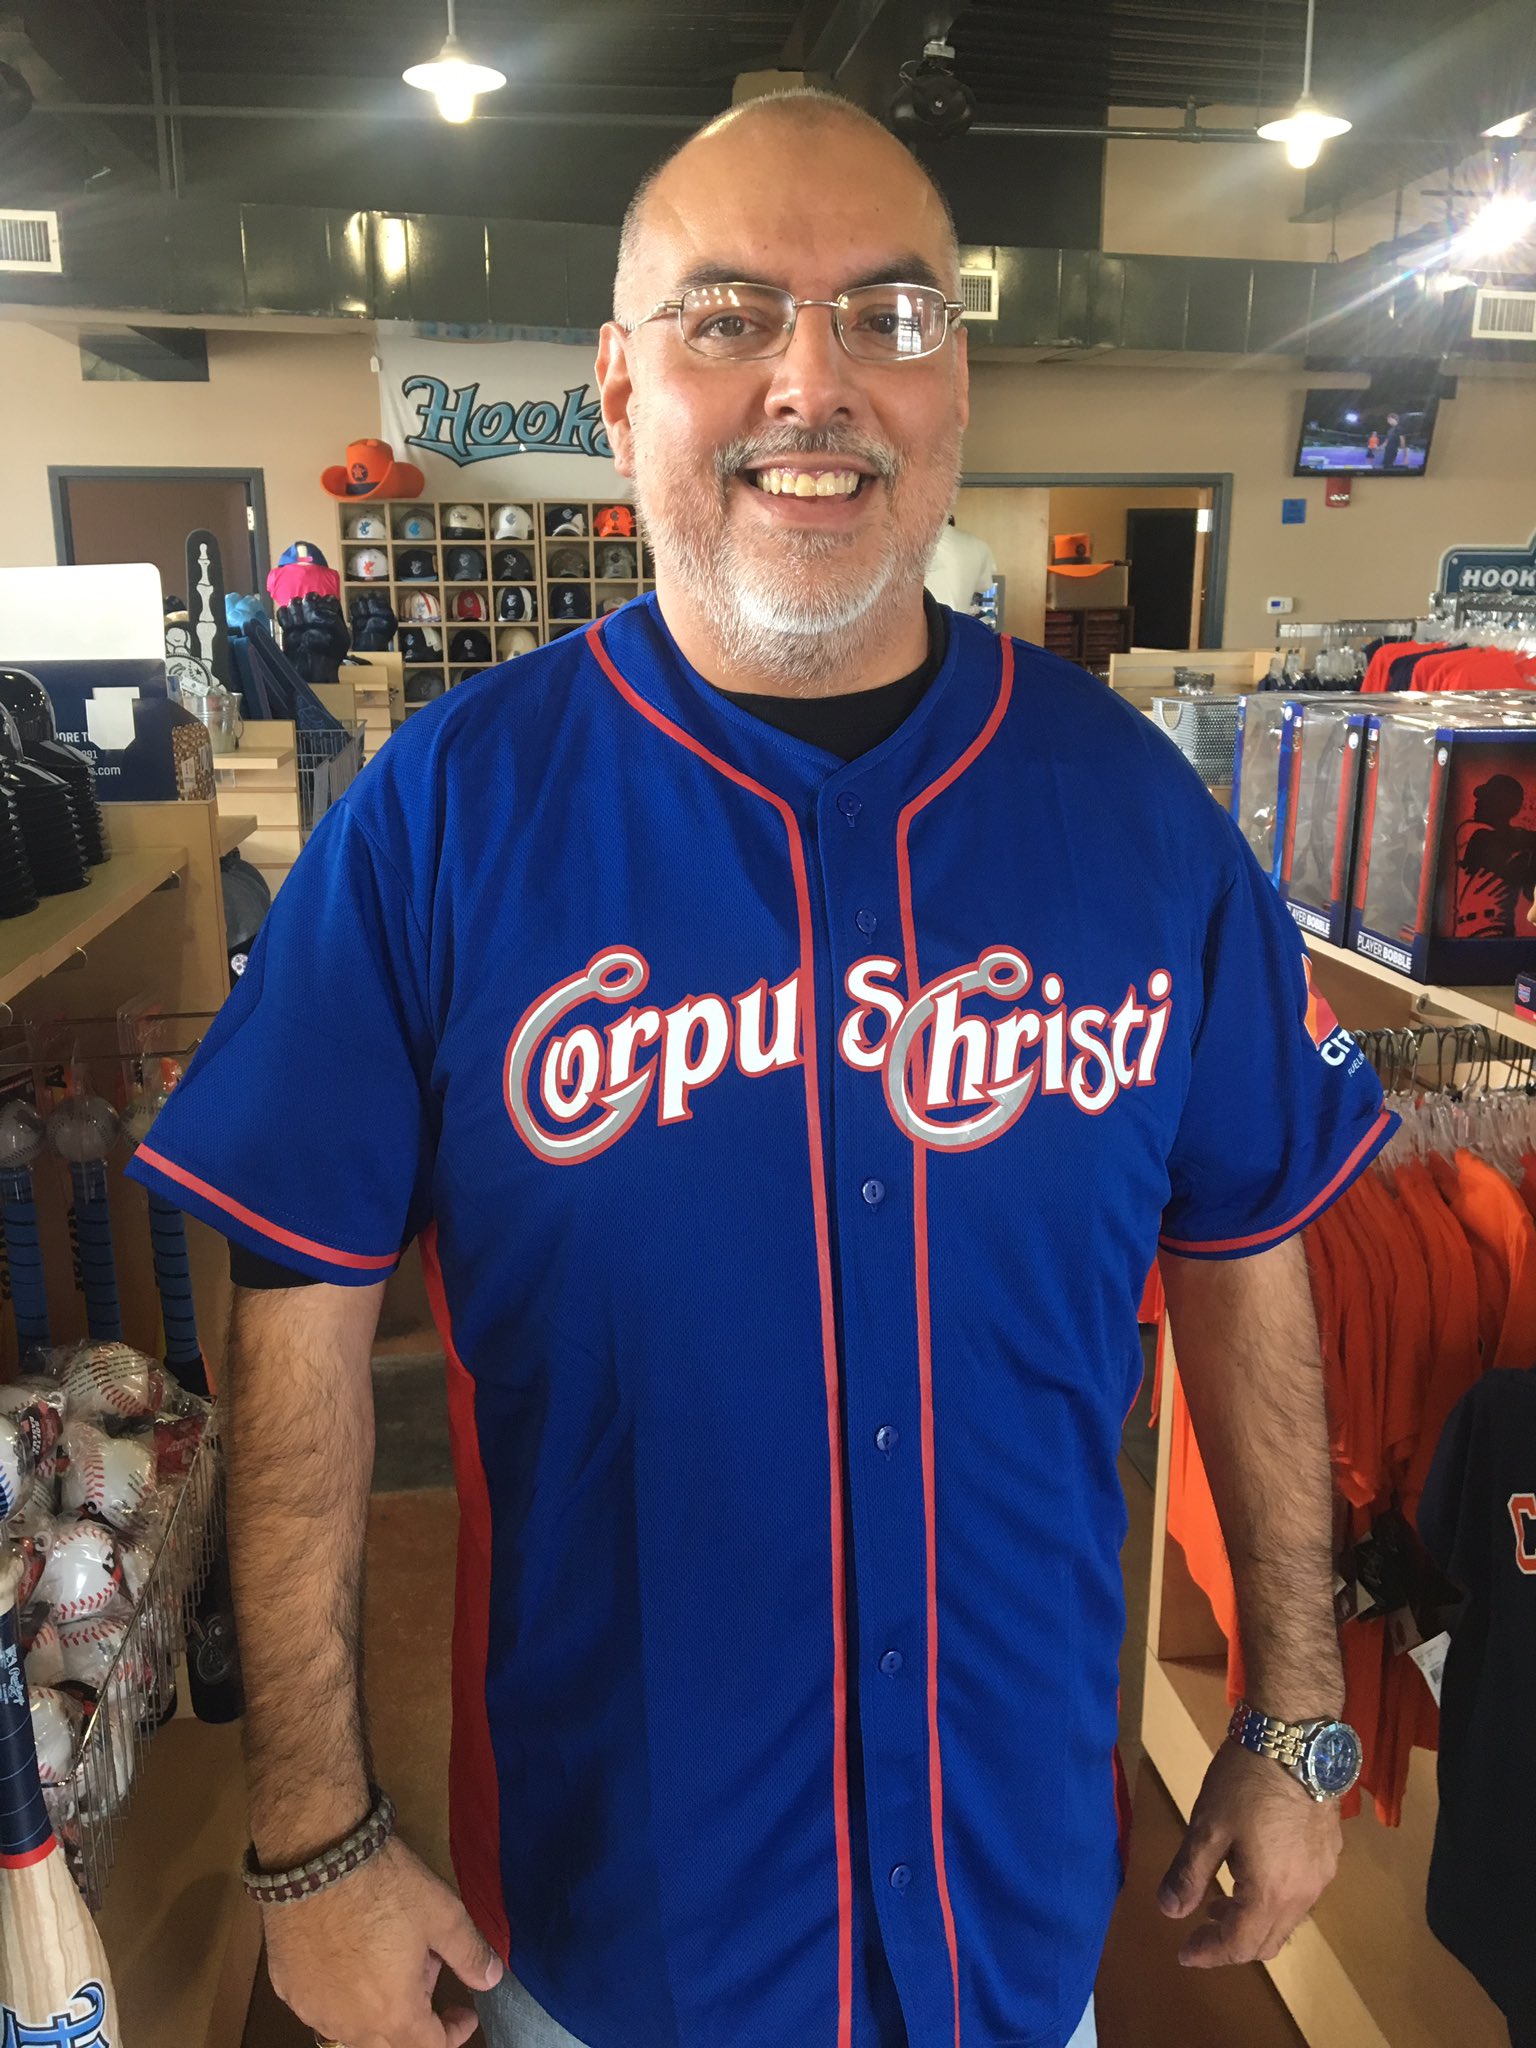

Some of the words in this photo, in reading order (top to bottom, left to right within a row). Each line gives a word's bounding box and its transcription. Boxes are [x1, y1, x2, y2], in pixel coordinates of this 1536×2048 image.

[55, 732, 80, 742] ORE
[90, 766, 121, 776] .com
[1306, 914, 1331, 935] BOBBLE
[1357, 934, 1383, 957] PLAYER
[1382, 945, 1412, 970] BOBBLE
[884, 945, 1171, 1152] Christi
[1321, 1029, 1355, 1066] CIT
